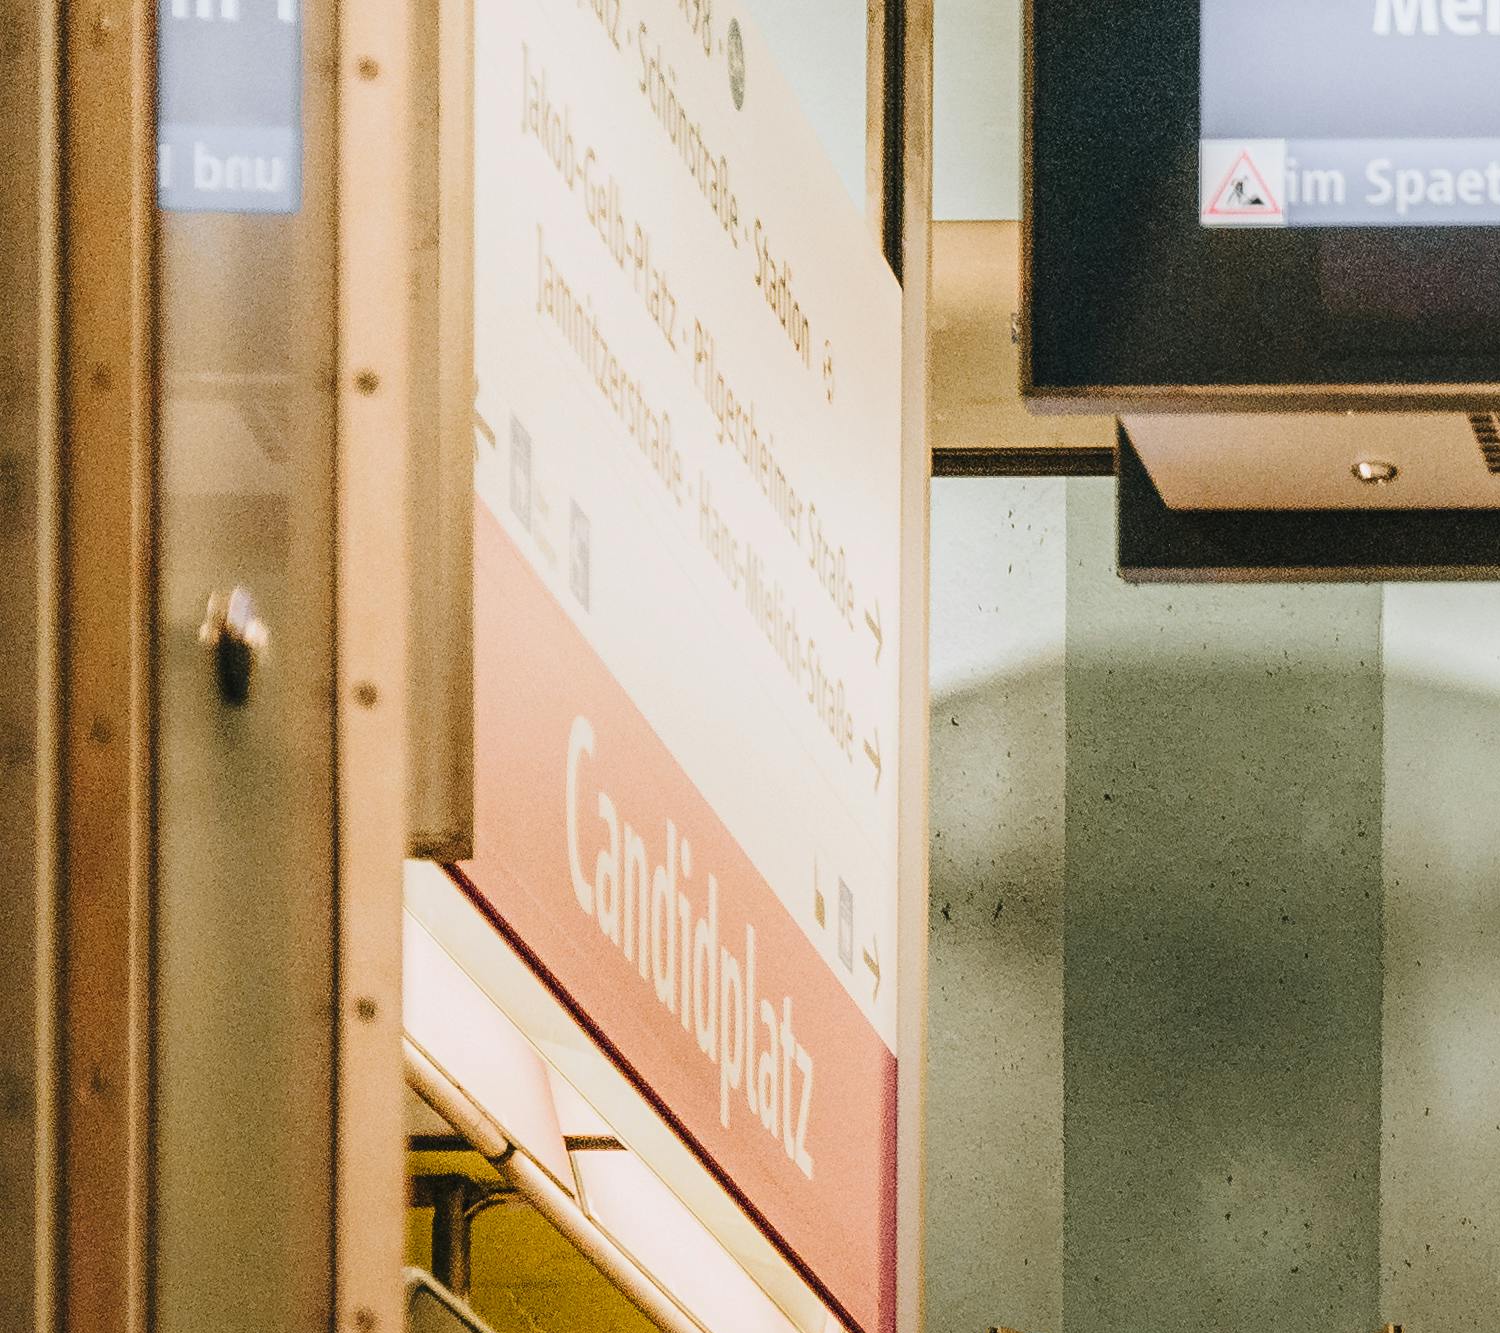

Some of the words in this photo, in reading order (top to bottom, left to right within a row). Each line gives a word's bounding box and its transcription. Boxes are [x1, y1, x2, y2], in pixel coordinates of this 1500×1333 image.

[521, 41, 676, 352] Jakob-Gelb-Platz
[694, 316, 802, 547] Pilgersheimer
[809, 502, 854, 631] Straße
[754, 216, 809, 369] Stadion
[566, 715, 815, 1180] Candidplatz
